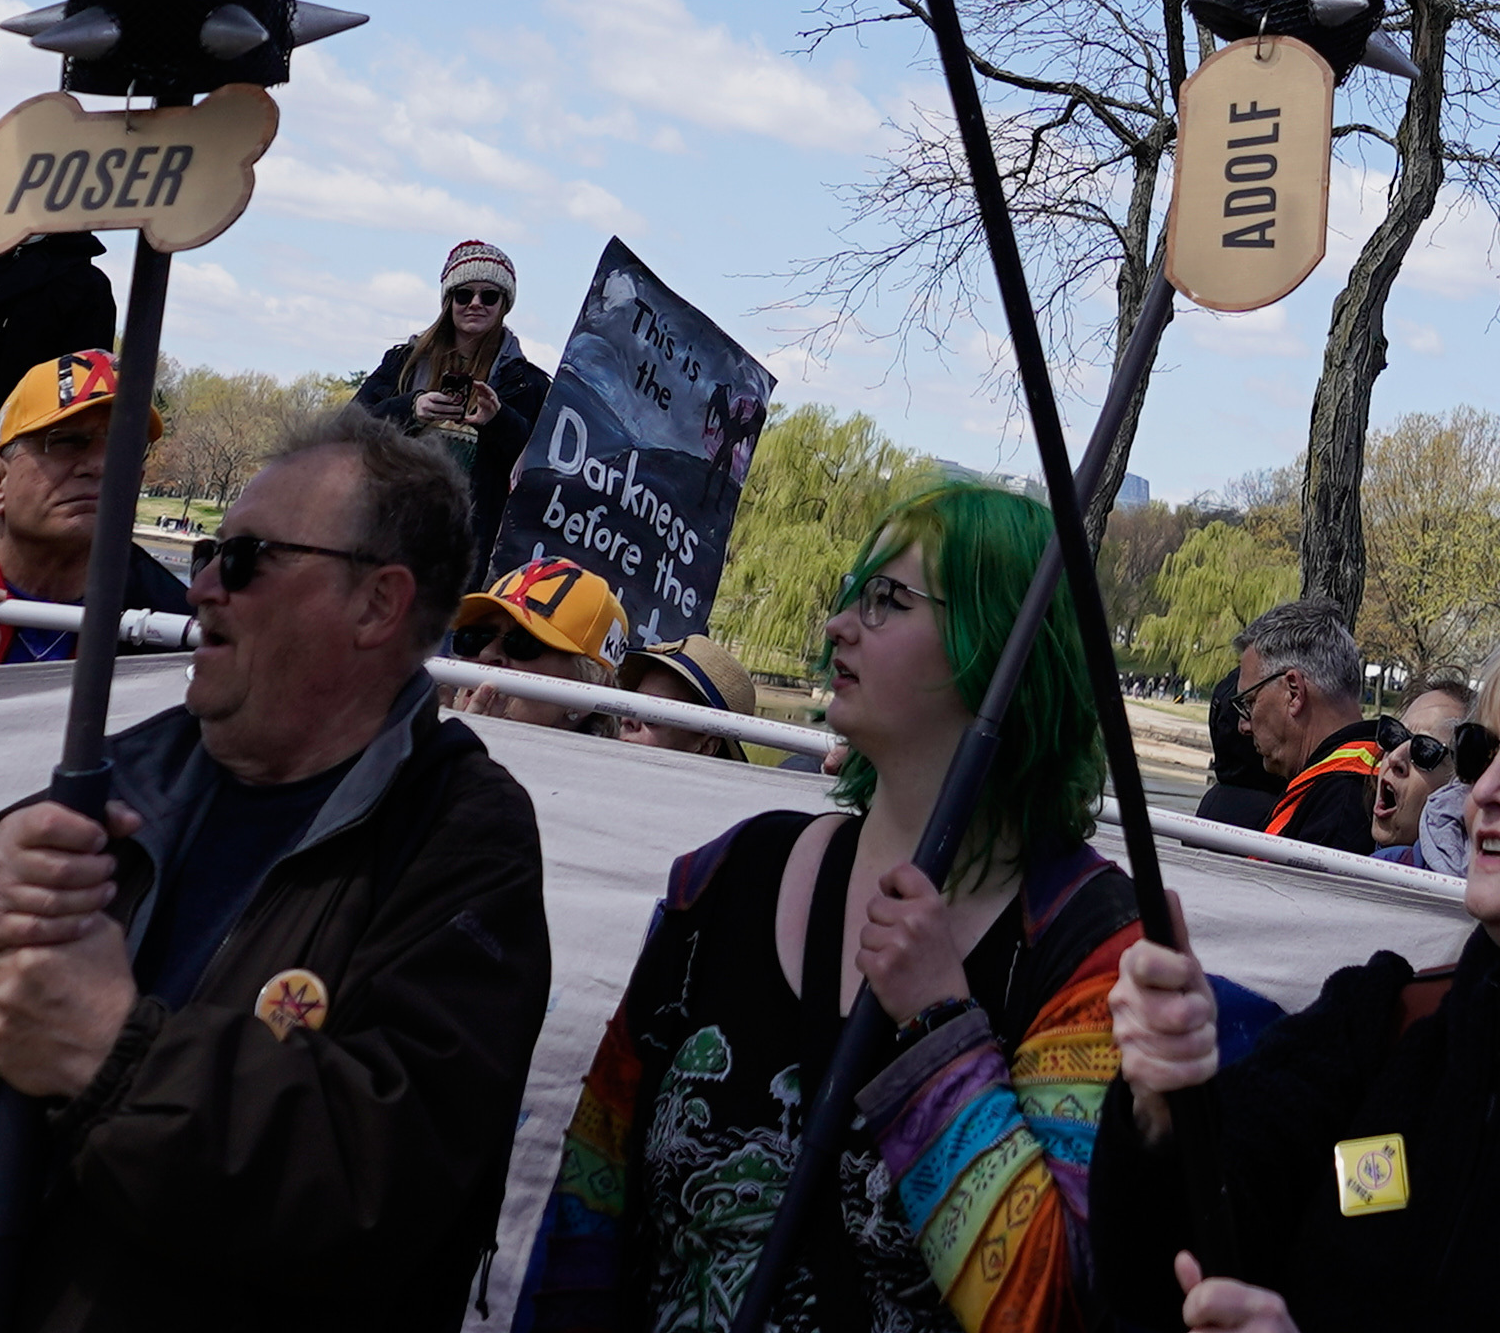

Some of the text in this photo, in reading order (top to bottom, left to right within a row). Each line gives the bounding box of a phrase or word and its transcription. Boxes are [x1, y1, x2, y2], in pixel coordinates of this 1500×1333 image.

[4, 144, 195, 216] POSER
[1221, 99, 1282, 249] ADOLF
[630, 296, 701, 381] This is
[634, 358, 673, 412] the
[546, 405, 700, 566] Darkness
[541, 483, 643, 577] before
[655, 551, 700, 619] the
